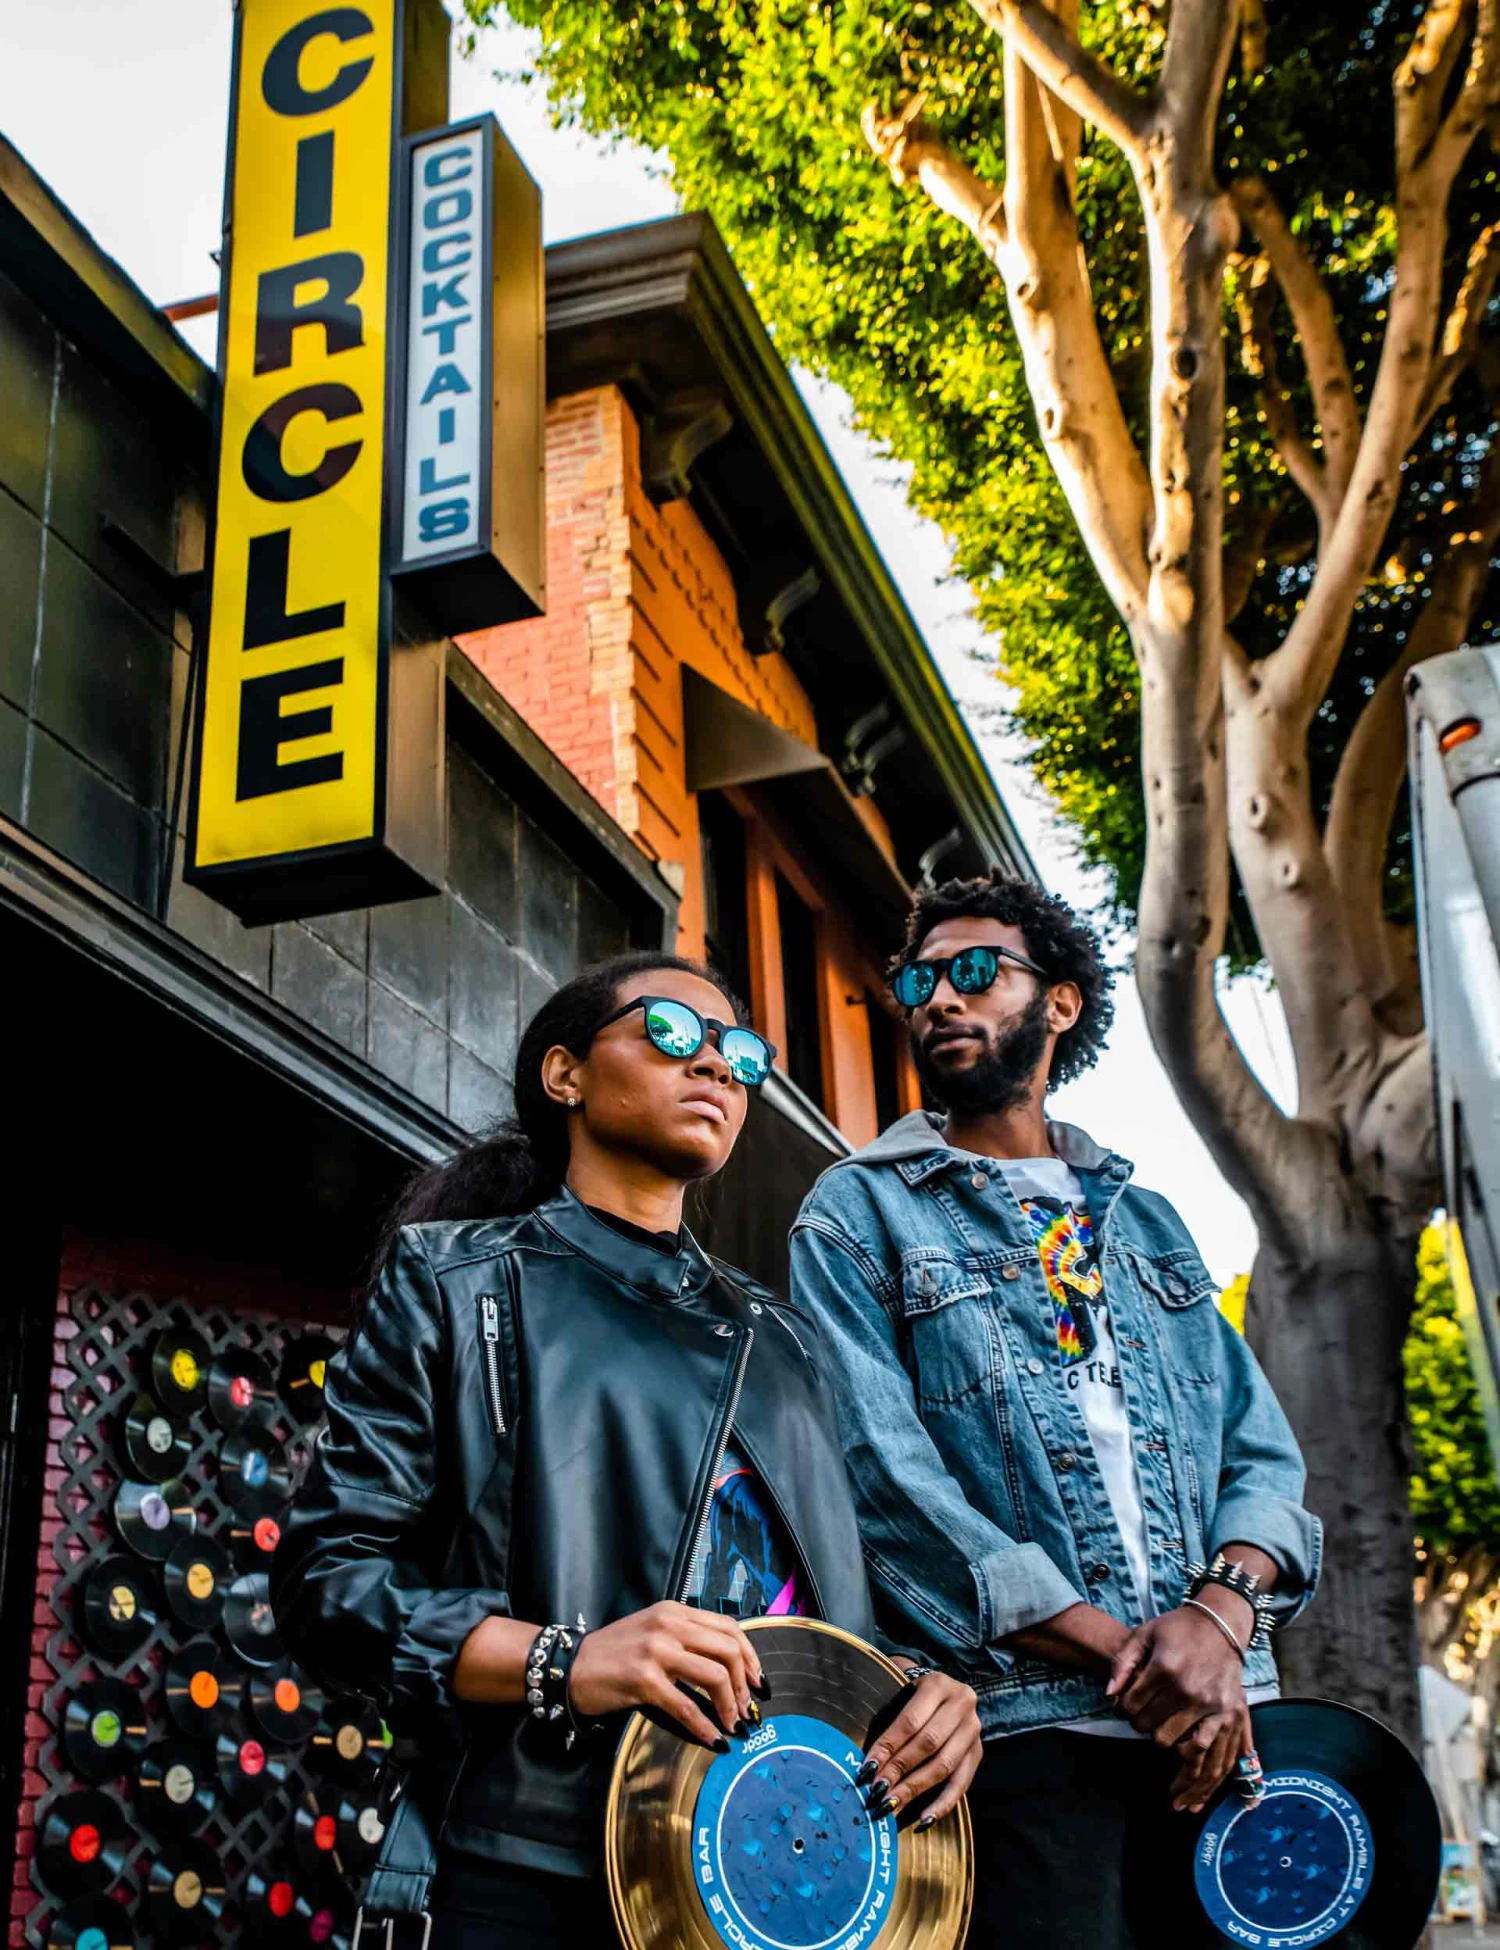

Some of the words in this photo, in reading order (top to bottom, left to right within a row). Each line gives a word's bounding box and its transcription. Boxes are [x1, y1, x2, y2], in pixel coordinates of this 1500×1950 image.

[419, 145, 473, 543] COCKTAILS
[236, 7, 375, 803] CIRCLE
[742, 1724, 776, 1754] goodr
[1263, 1776, 1352, 1809] MIDNIGHT
[845, 1751, 891, 1885] MIGHT
[698, 1827, 714, 1884] BAR
[1349, 1814, 1368, 1890] RAMBLE
[1339, 1894, 1355, 1917] AT
[1227, 1920, 1262, 1944] BAR
[1267, 1918, 1337, 1948] CIRCLE
